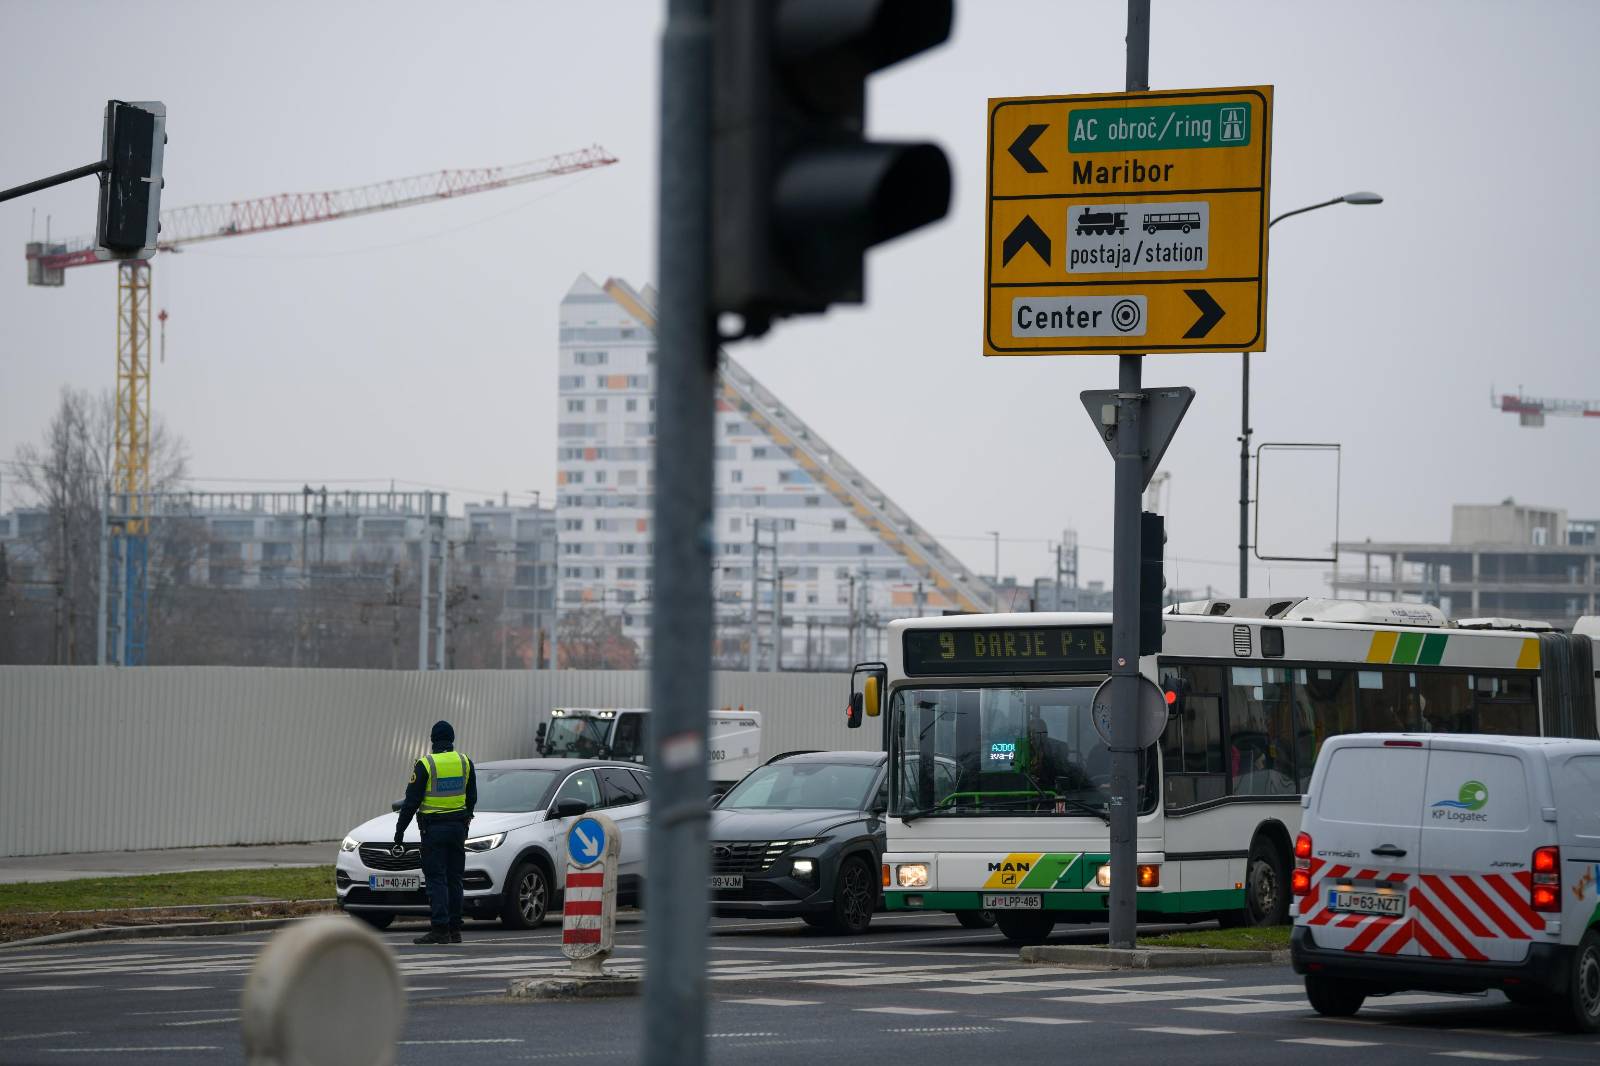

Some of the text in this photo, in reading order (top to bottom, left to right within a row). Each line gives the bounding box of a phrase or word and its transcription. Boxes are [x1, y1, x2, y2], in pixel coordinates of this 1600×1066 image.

[1073, 111, 1212, 143] AC obroč/ring
[1072, 159, 1174, 185] Maribor
[1017, 305, 1103, 330] Center
[939, 632, 956, 659] 9
[974, 631, 1048, 657] BARJE
[1432, 810, 1488, 823] KP Logatec
[987, 862, 1030, 872] MAN
[376, 878, 385, 887] LJ
[1338, 893, 1400, 912] LJ 63-NZT
